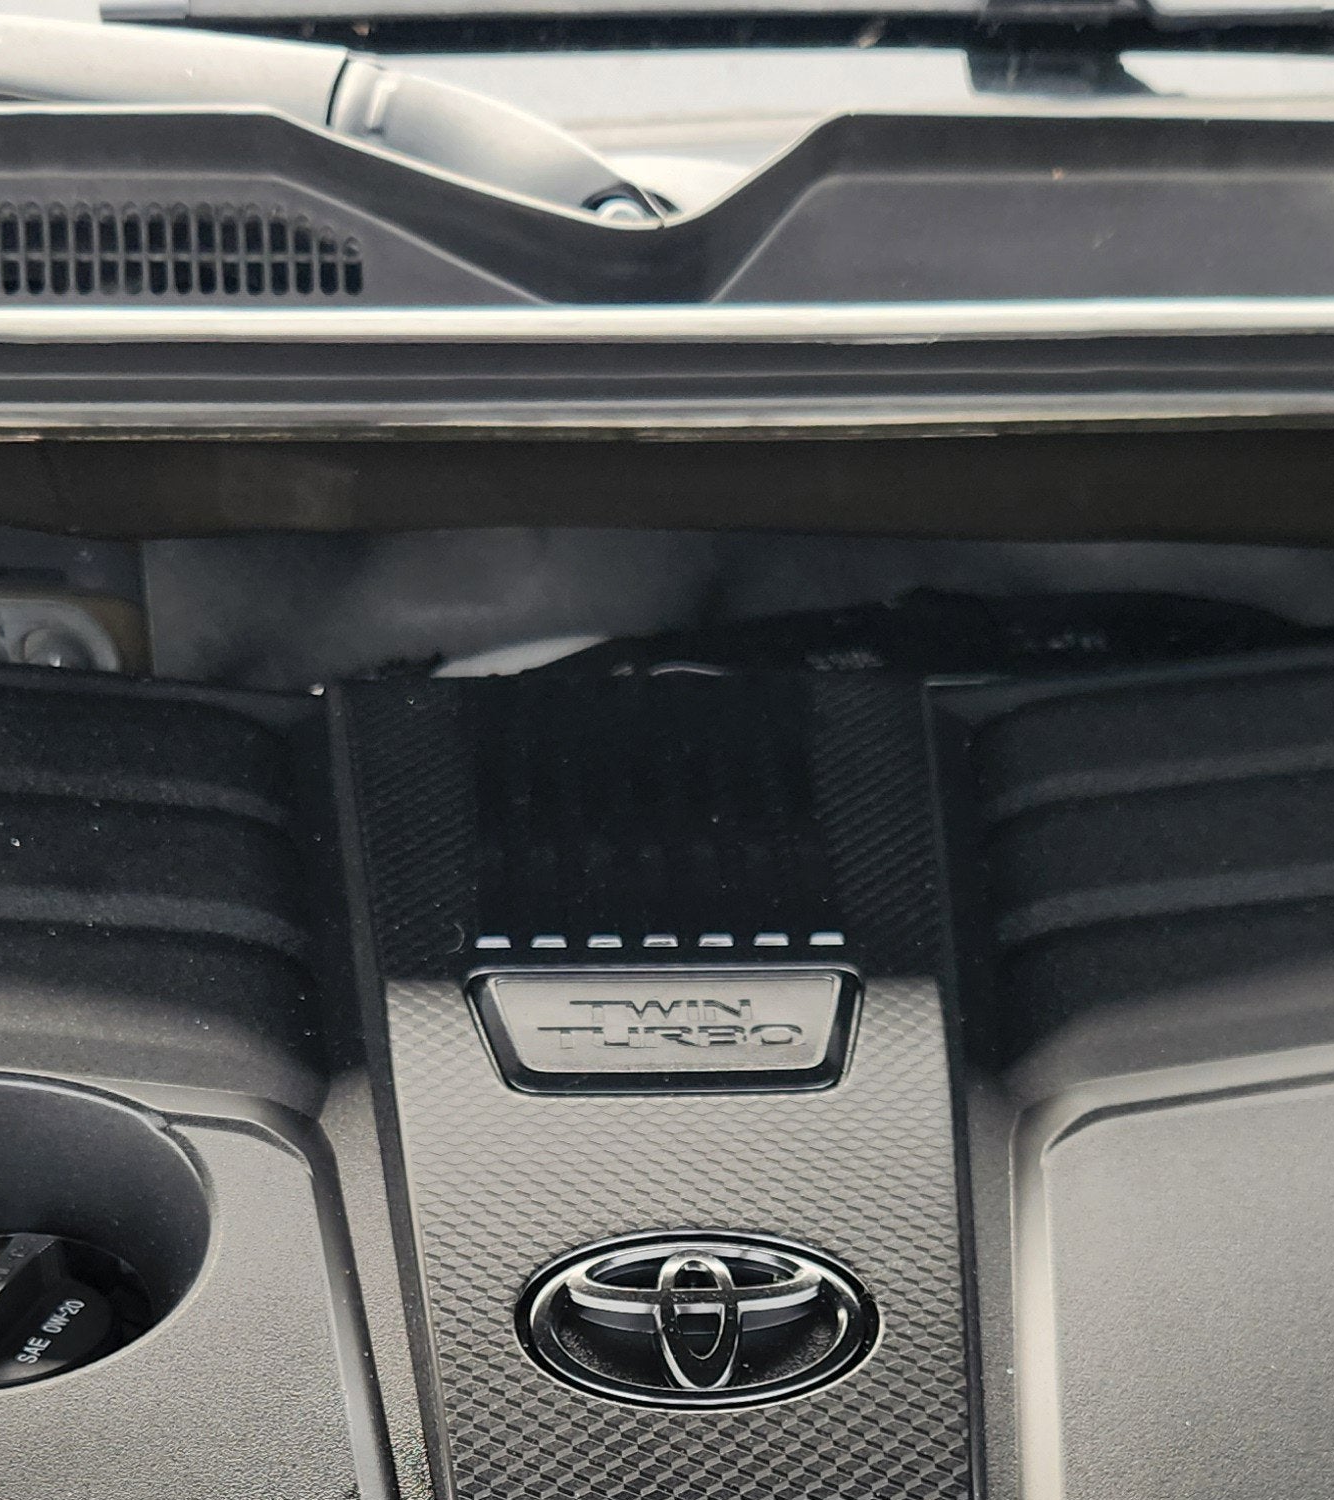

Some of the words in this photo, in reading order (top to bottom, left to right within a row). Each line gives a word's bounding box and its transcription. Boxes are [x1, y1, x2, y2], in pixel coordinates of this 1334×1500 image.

[569, 998, 753, 1022] TWIN
[537, 1023, 805, 1049] TURBO
[17, 1336, 51, 1365] SAE
[41, 1298, 86, 1335] 0W-20
